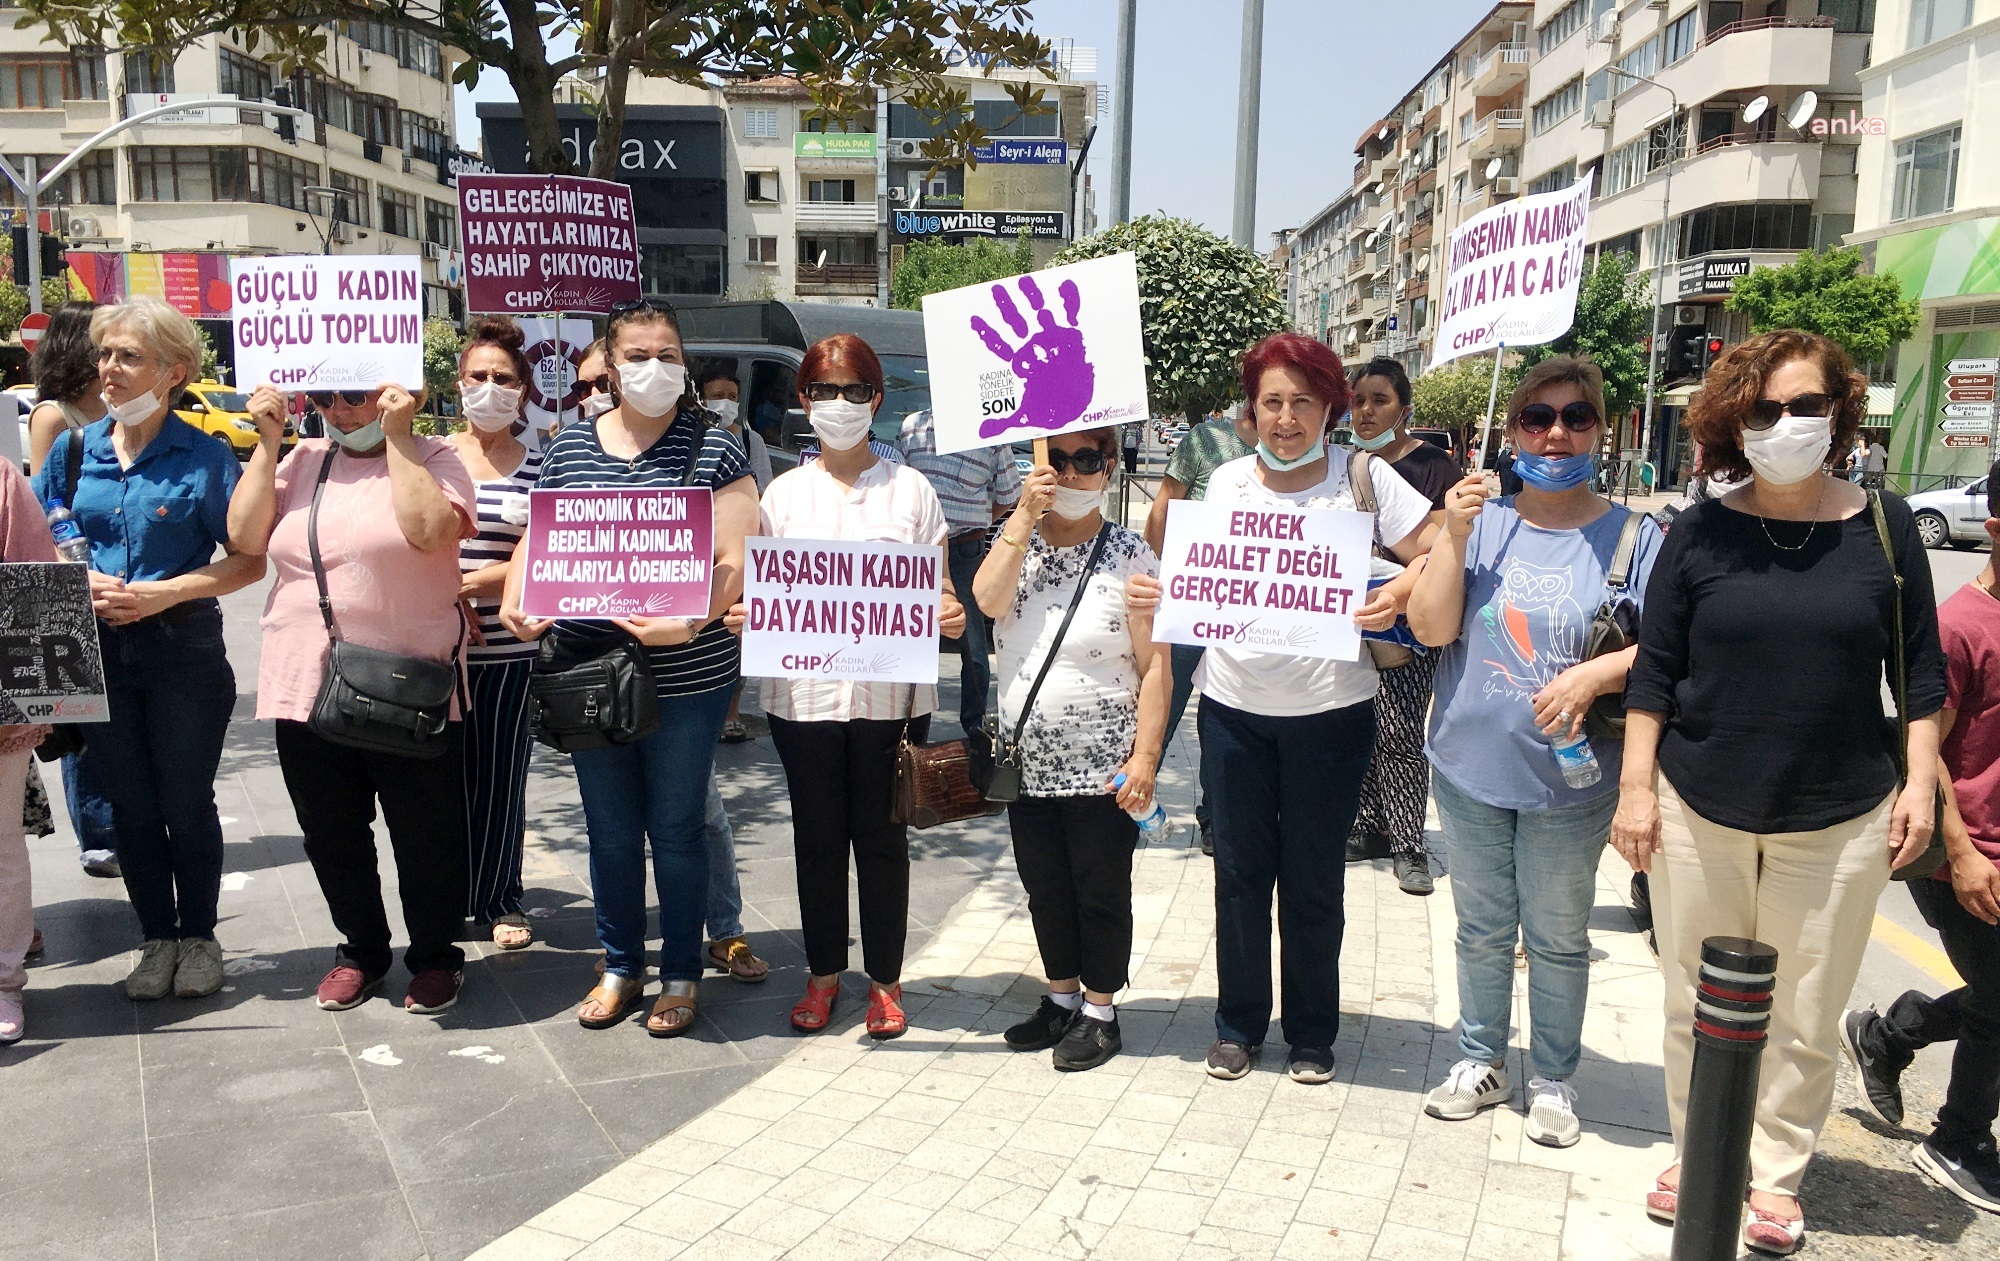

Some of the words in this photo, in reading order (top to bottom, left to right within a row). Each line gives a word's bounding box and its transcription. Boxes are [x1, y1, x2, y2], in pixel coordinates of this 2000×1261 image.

[1000, 145, 1031, 160] Seyr-i
[1034, 145, 1061, 158] Alem
[465, 184, 605, 217] GELECEĞİMİZE
[608, 195, 629, 221] VE
[1006, 215, 1046, 225] Epilasyon
[1048, 215, 1054, 223] &
[468, 222, 633, 251] HAYATLARIMIZA
[1451, 206, 1518, 277] KİMSENİN
[1522, 185, 1589, 246] NAMUSU
[470, 248, 531, 277] SAHİP
[540, 253, 636, 282] ÇIKIYORUZ
[1707, 263, 1746, 275] AVUKAT
[237, 264, 317, 310] GÜÇLÜ
[338, 270, 417, 300] KADIN
[1444, 237, 1583, 323] OLMAYACAĞIZ
[505, 291, 543, 307] CHP
[554, 298, 586, 306] KOLLARI
[239, 307, 313, 354] GÜÇLÜ
[321, 313, 418, 344] TOPLUM
[1496, 330, 1535, 339] KOLLARI
[1497, 321, 1529, 330] KADIN
[1453, 328, 1485, 349] CHP
[541, 359, 567, 372] 624
[269, 368, 307, 383] CHP
[979, 369, 1012, 381] KADINA
[979, 377, 1014, 391] YÖNELİK
[980, 387, 1015, 401] ŞİDDETE
[982, 397, 1016, 415] SON
[1083, 412, 1102, 423] CHP
[555, 492, 633, 522] EKONOMİK
[637, 492, 687, 521] KRİZİN
[1229, 511, 1306, 541] ERKEK
[548, 524, 615, 552] BEDELİNİ
[619, 529, 694, 552] KADINLAR
[532, 559, 625, 583] CANLARIYLA
[629, 555, 705, 582] ÖDEMESİN
[1185, 543, 1271, 572] ADALET
[1276, 545, 1343, 579] DEĞİL
[751, 549, 853, 593] YAŞASIN
[862, 554, 935, 590] KADIN
[1170, 575, 1260, 610] GERÇEK
[1264, 583, 1353, 615] ADALET
[558, 597, 598, 612] CHP
[750, 597, 934, 644] DAYANIŞMASI
[1193, 622, 1235, 640] CHP
[1249, 627, 1280, 636] KADIN
[1248, 636, 1286, 646] KOLLARI
[781, 655, 822, 670] CHP
[1482, 680, 1514, 701] You're
[27, 704, 54, 717] CHP
